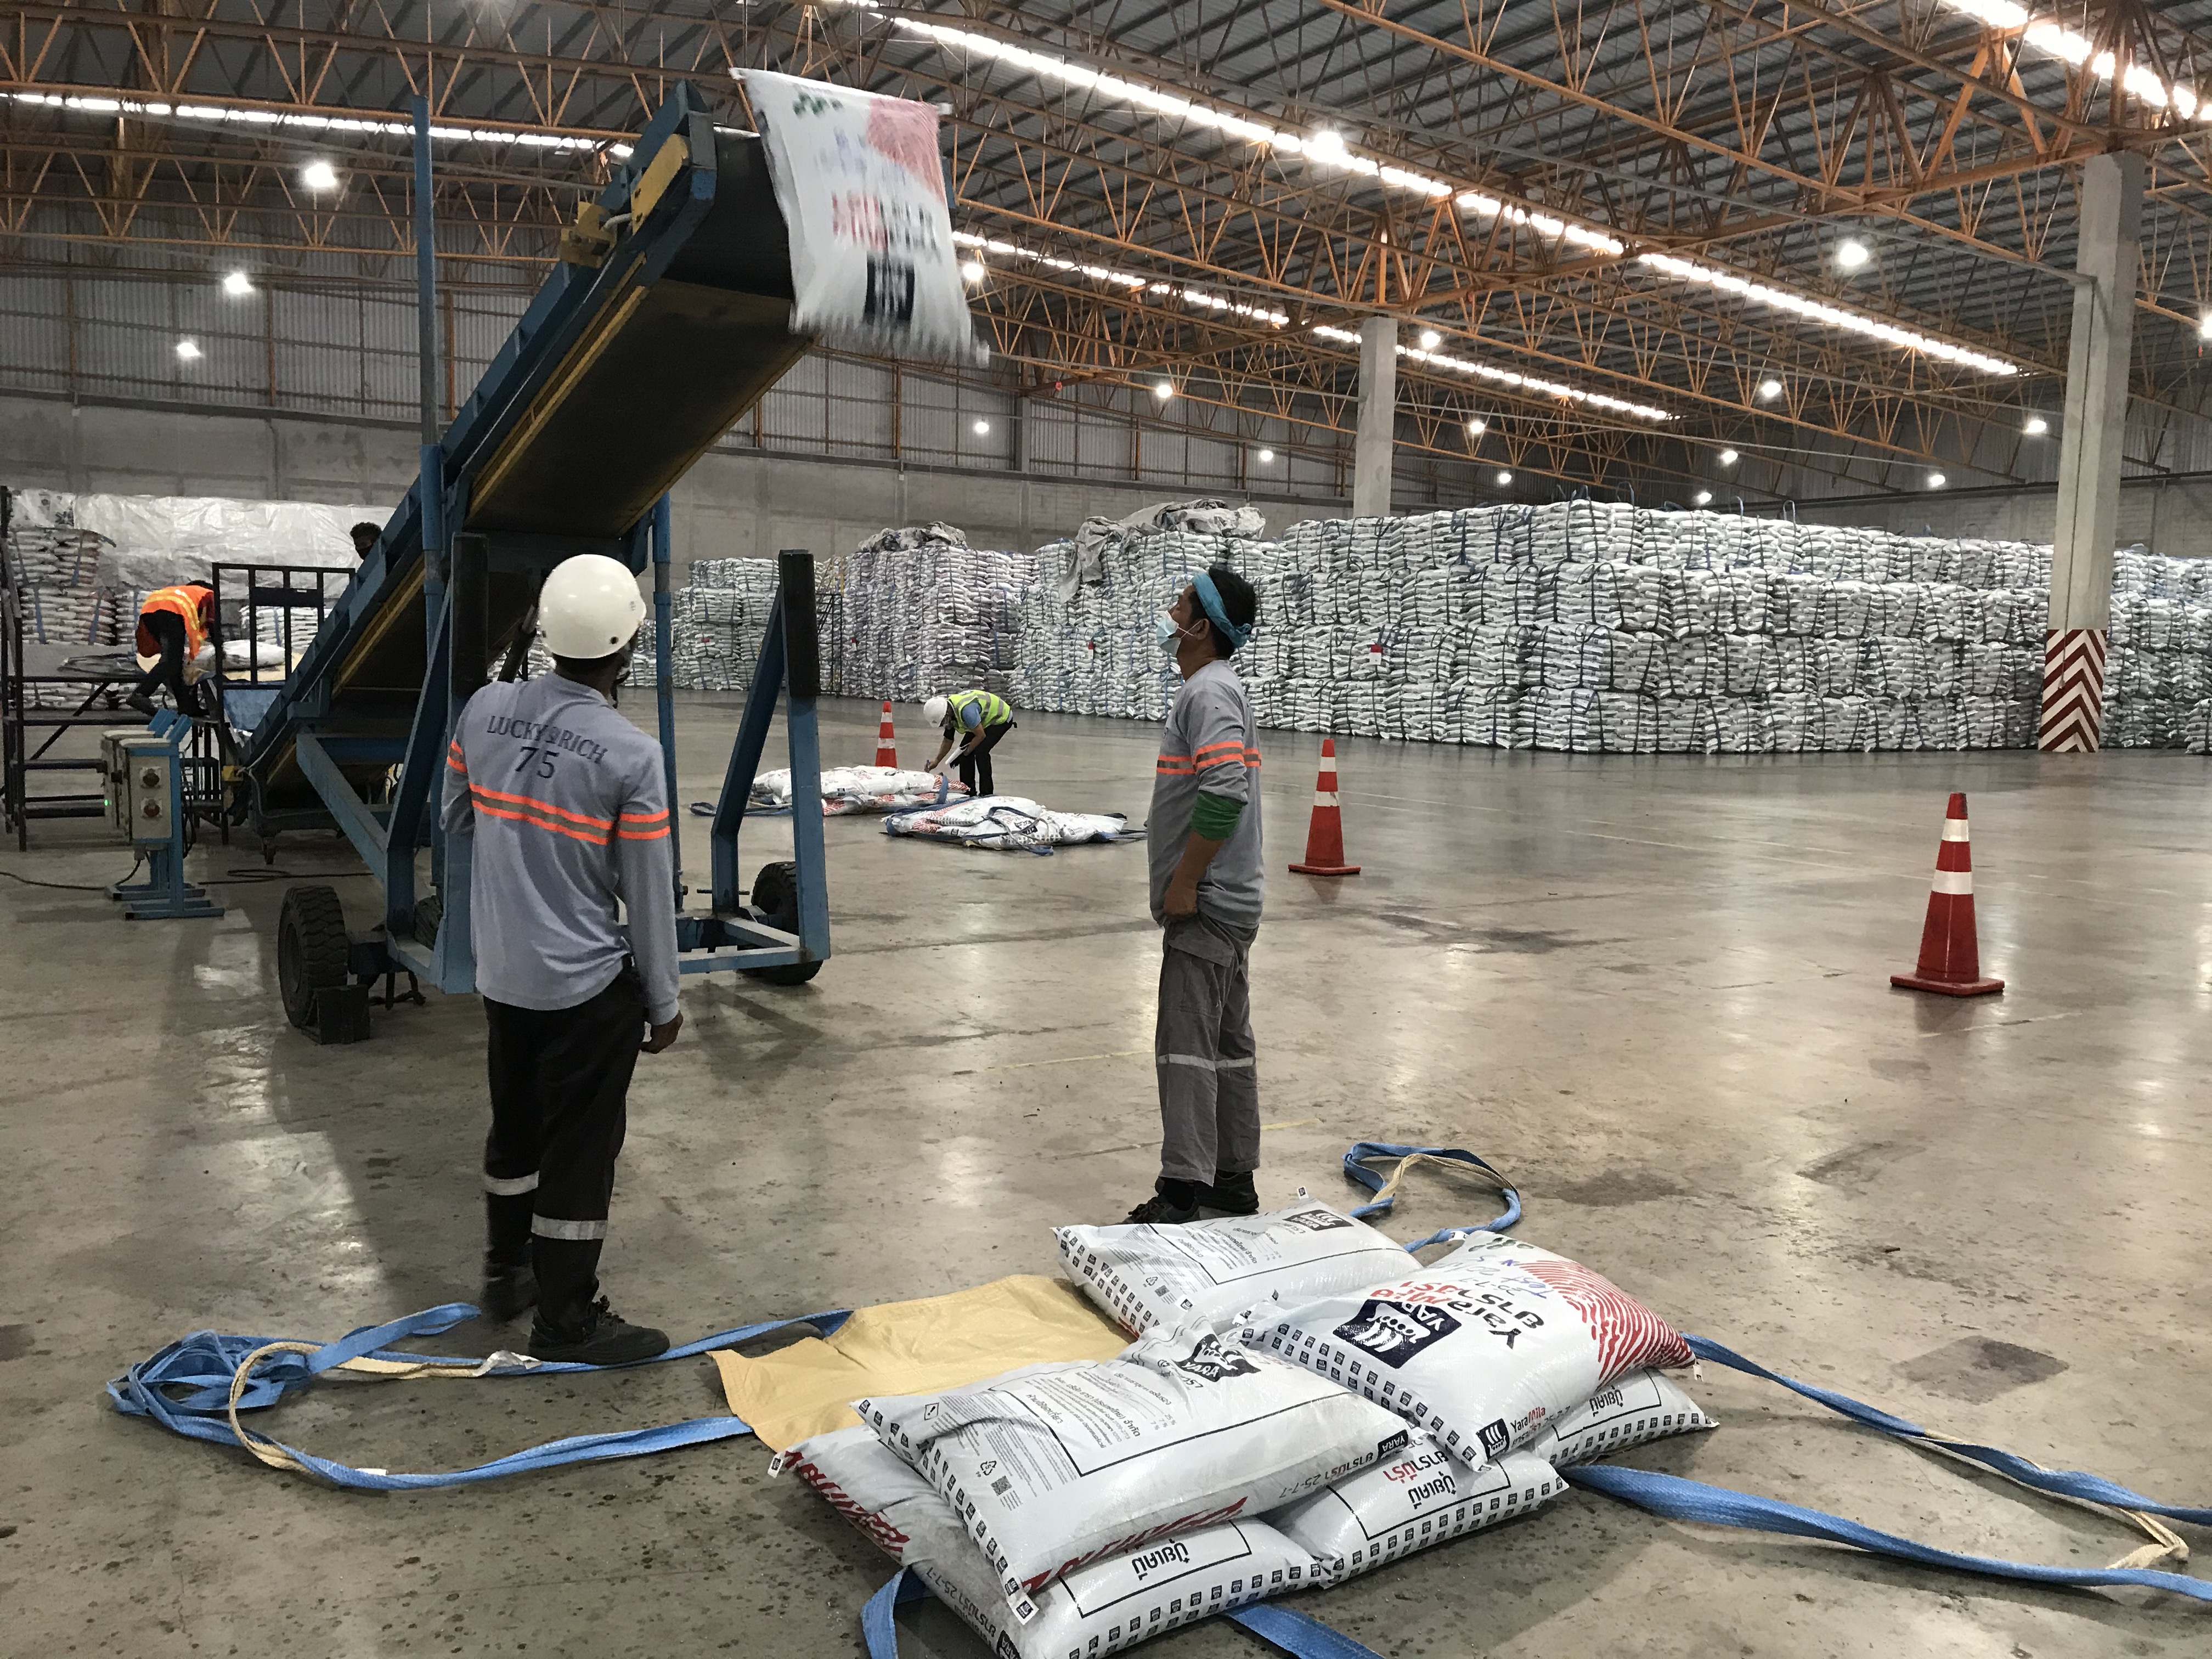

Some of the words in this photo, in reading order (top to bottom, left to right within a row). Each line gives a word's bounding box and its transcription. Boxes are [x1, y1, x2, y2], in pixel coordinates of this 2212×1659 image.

[515, 746, 560, 778] 75
[1401, 1301, 1446, 1331] YAR
[1181, 1362, 1220, 1378] YARA
[1589, 1385, 1624, 1418] ปุ๋ยเคมี
[1123, 1419, 1141, 1437] จำกัด
[1510, 1406, 1546, 1433] YaraMila
[1382, 1434, 1406, 1452] YARA
[1383, 1451, 1449, 1484] ยารามีร่า
[1279, 1474, 1322, 1499] 25-7-7
[1407, 1471, 1457, 1510] ปุ๋ยเคมี
[1131, 1537, 1190, 1581] ปุ๋ยเคมี
[926, 1566, 958, 1599] 25-7-7
